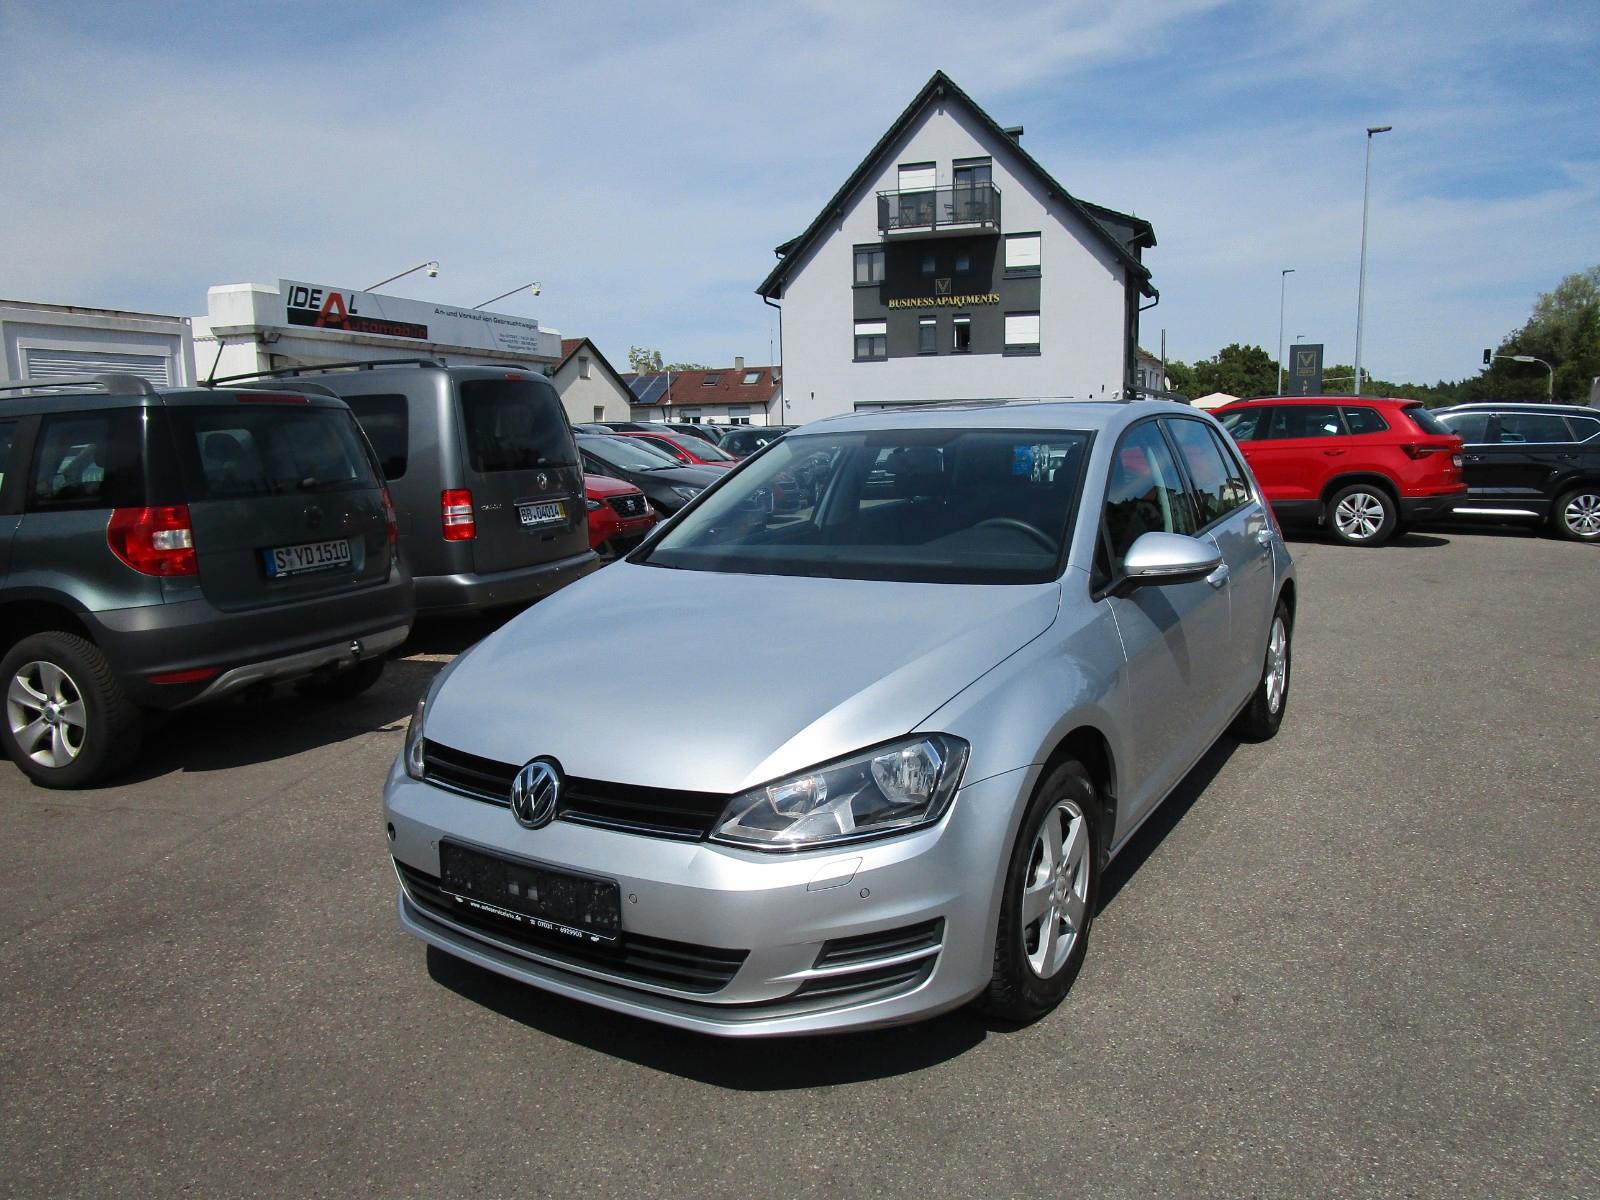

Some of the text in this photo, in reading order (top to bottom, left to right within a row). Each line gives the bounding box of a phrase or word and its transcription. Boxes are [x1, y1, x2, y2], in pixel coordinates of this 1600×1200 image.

[287, 285, 358, 329] IDEAL
[888, 292, 1000, 308] BUSINESS APARTMENTS
[446, 310, 458, 318] und
[458, 311, 482, 321] Verkauf
[493, 317, 538, 330] Gebrauchtwagen
[275, 542, 348, 569] S YD 1510
